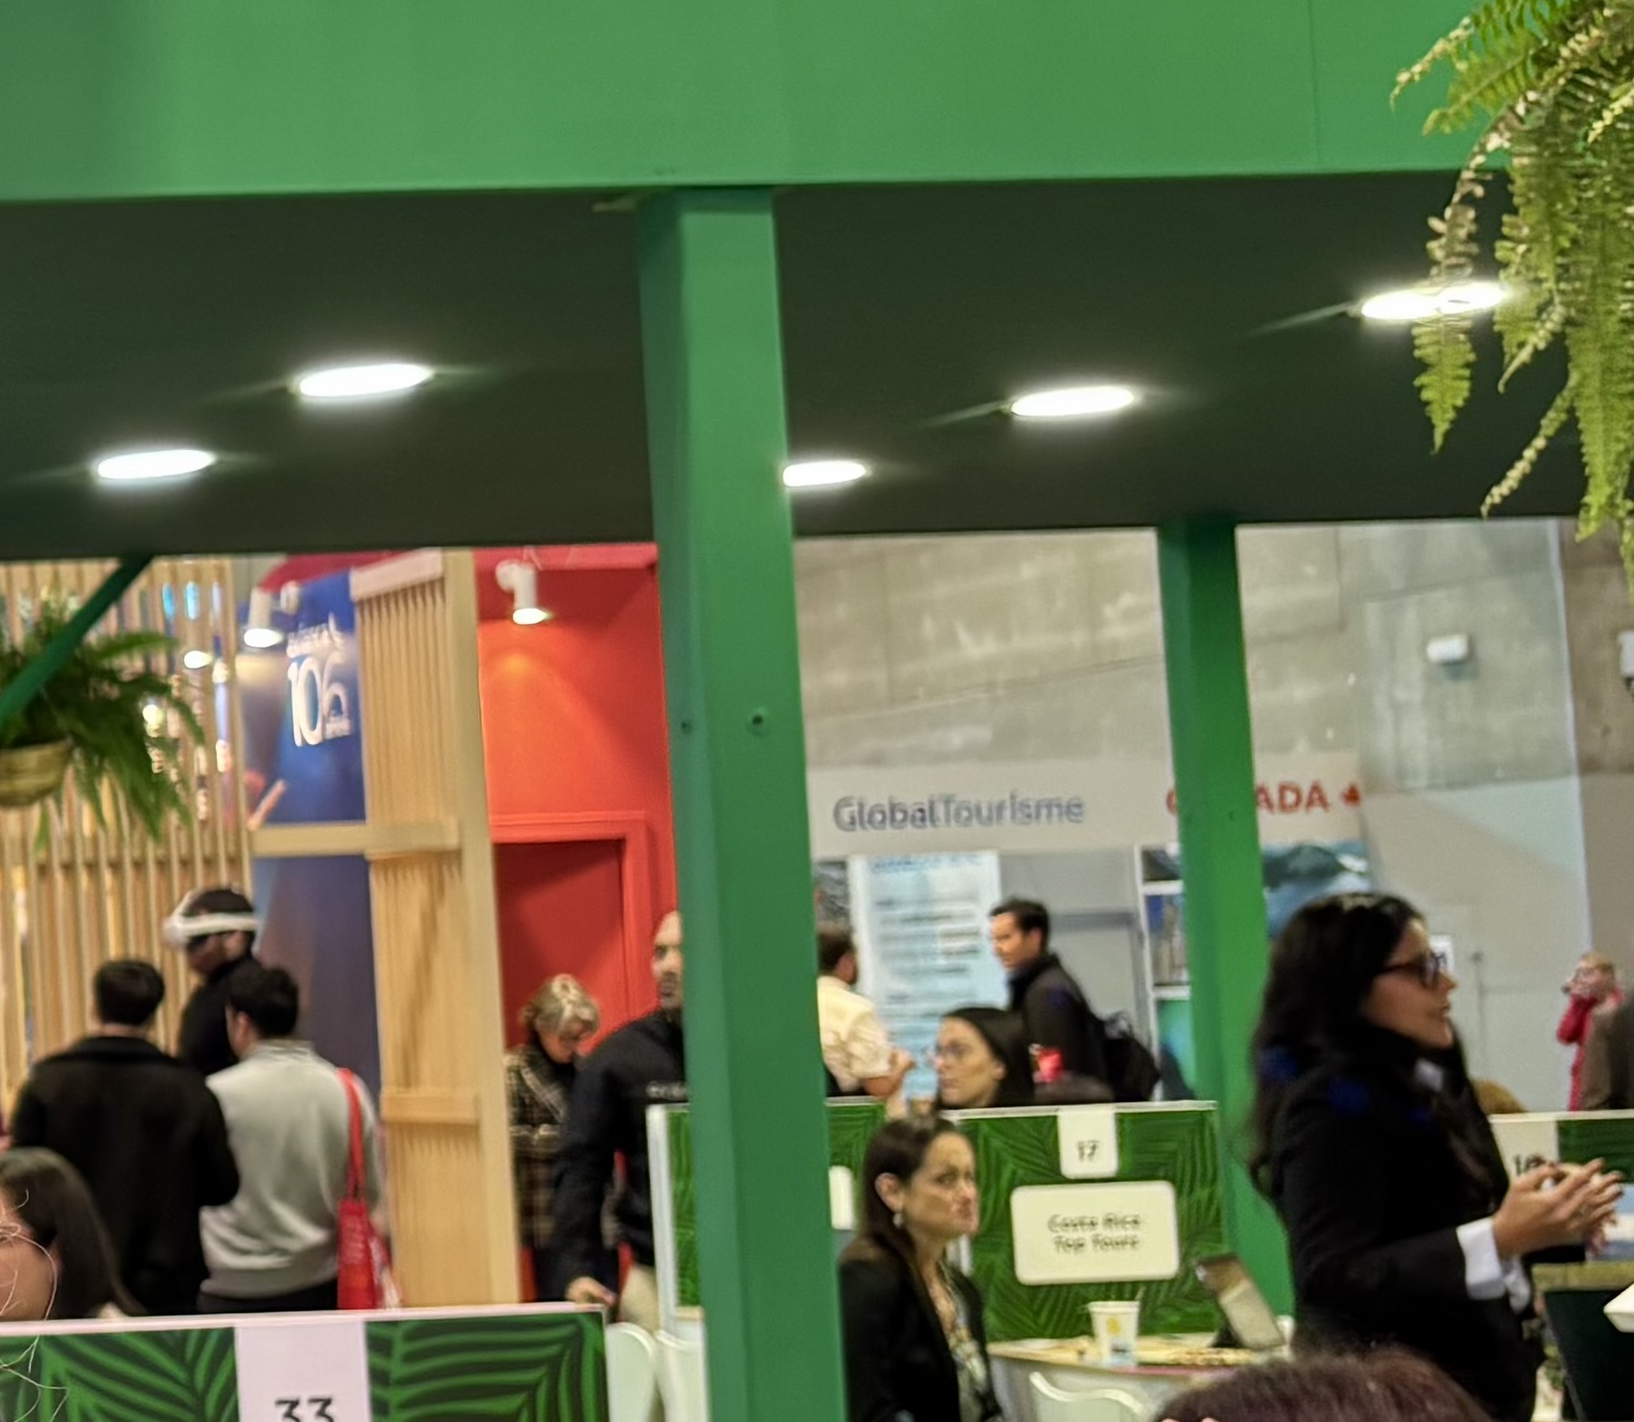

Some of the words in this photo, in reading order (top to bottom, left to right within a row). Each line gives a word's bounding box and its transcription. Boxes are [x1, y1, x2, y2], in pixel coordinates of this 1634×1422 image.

[1077, 1139, 1100, 1161] 17
[1047, 1213, 1099, 1233] Costa
[1102, 1212, 1142, 1230] Rica
